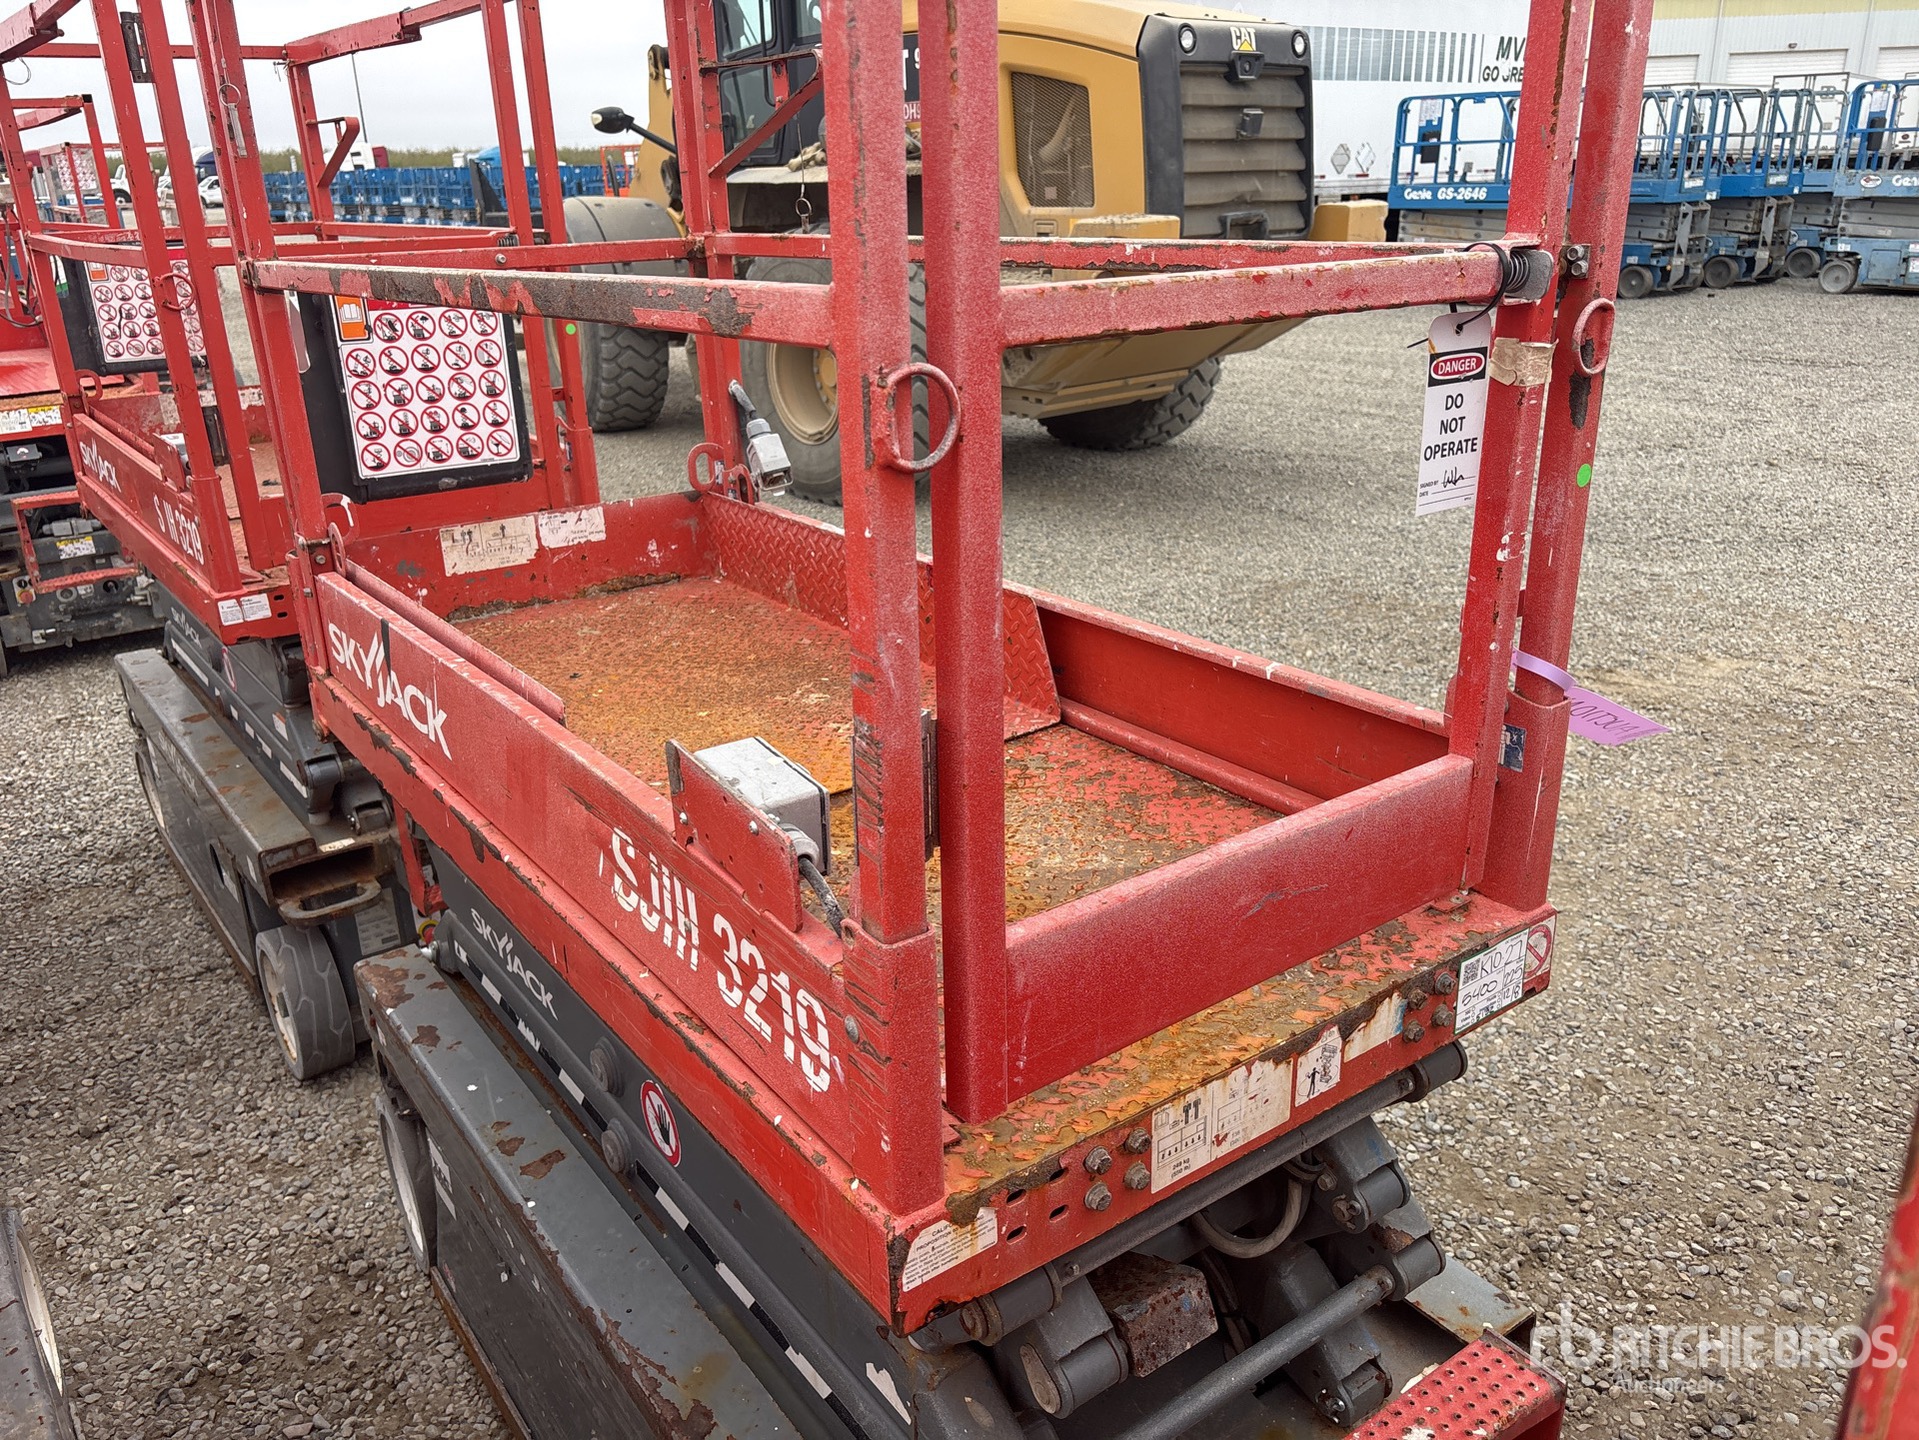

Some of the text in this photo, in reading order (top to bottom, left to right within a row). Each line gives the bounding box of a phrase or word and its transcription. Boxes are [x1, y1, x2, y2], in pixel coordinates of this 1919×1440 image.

[1230, 26, 1257, 51] CAT
[1496, 36, 1526, 61] MV
[1482, 65, 1499, 82] GO
[1404, 187, 1488, 201] Genie GS-2646
[1438, 358, 1477, 375] DANGER
[1445, 393, 1464, 411] DO
[1440, 416, 1466, 436] NOT
[1424, 437, 1478, 462] OPERATE
[79, 438, 122, 493] SKYJACK
[328, 622, 453, 762] SKYJACK
[470, 907, 559, 1021] SKYJACK
[713, 911, 832, 1093] 3219
